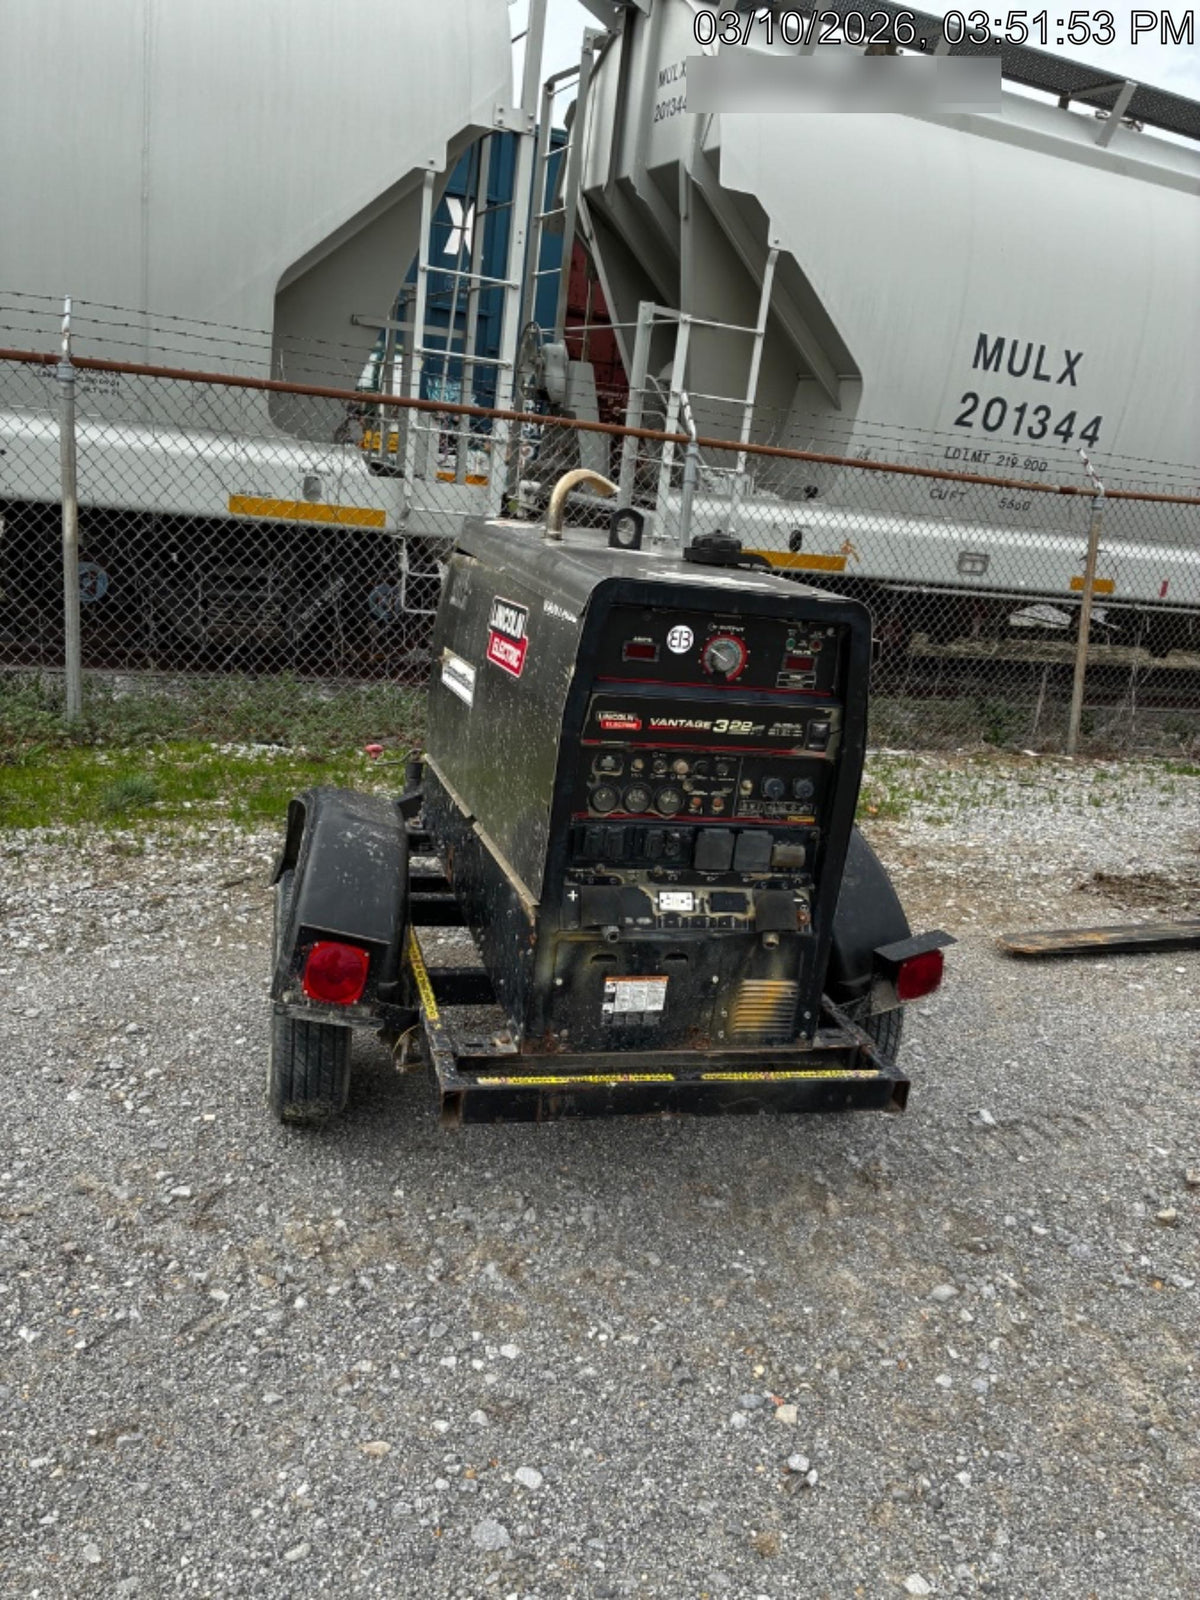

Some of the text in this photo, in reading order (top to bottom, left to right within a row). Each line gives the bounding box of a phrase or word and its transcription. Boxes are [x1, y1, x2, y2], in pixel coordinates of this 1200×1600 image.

[971, 331, 1084, 387] MULX
[953, 391, 1103, 449] 201344
[649, 717, 712, 730] VANTAGE
[712, 719, 754, 734] 322
